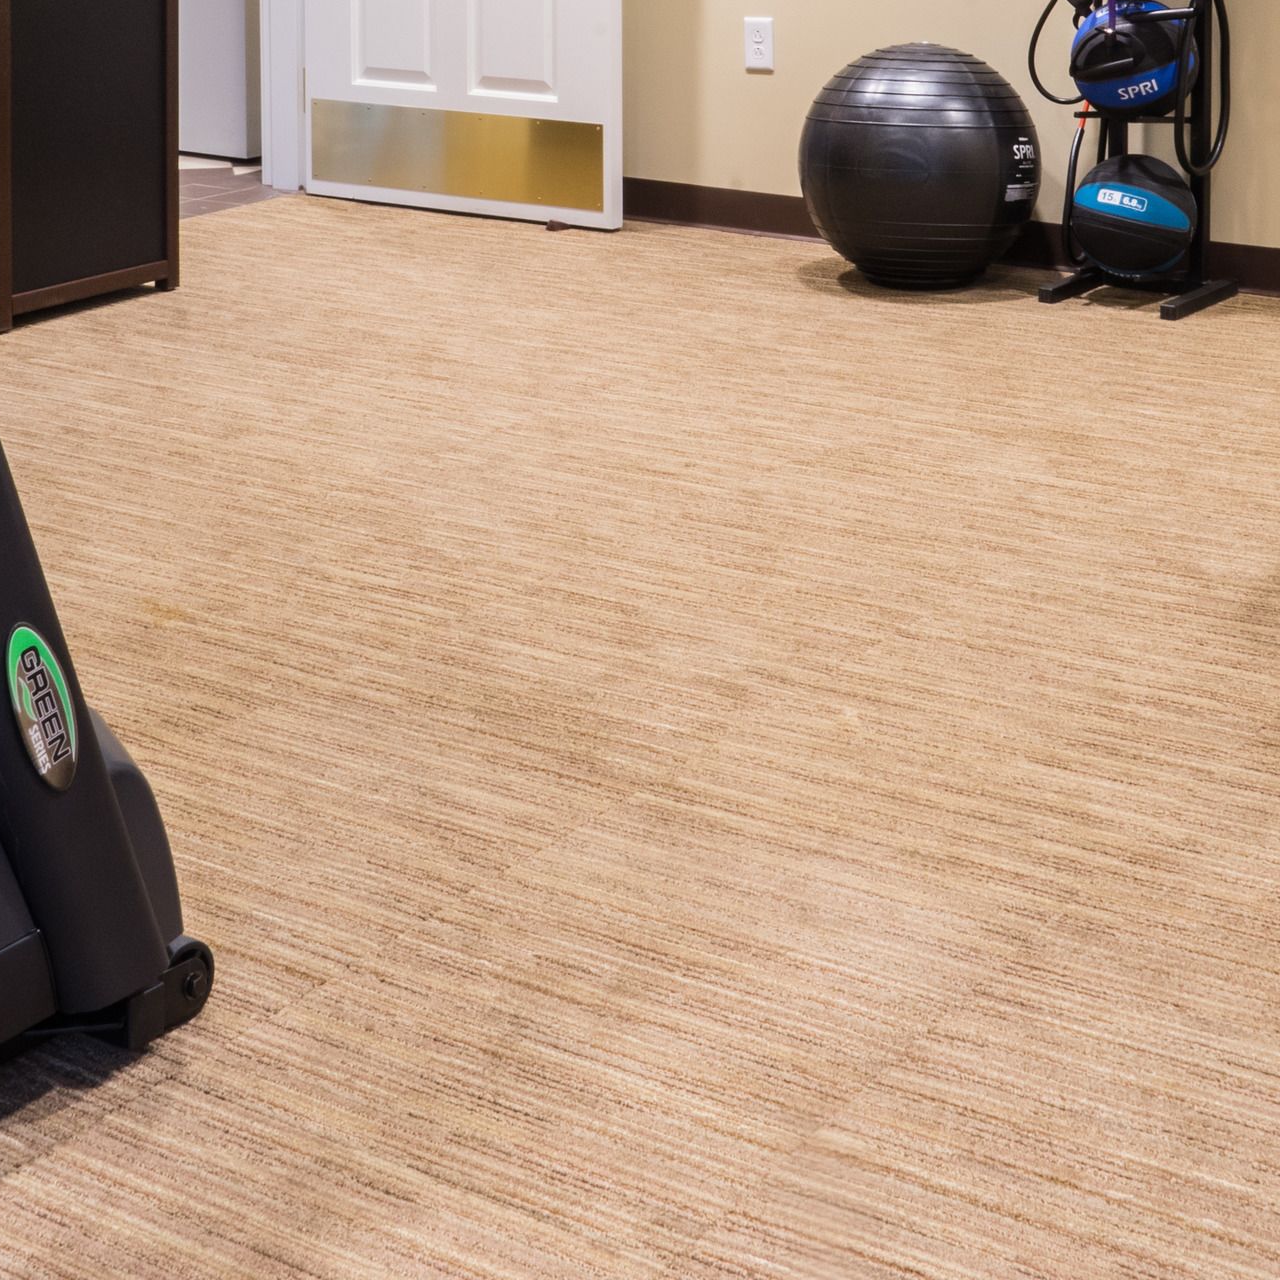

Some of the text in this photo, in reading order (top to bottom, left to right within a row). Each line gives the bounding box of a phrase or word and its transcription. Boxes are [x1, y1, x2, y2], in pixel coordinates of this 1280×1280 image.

[1118, 78, 1158, 100] SPRI
[21, 644, 71, 765] GREEN
[28, 723, 52, 775] SERIES
